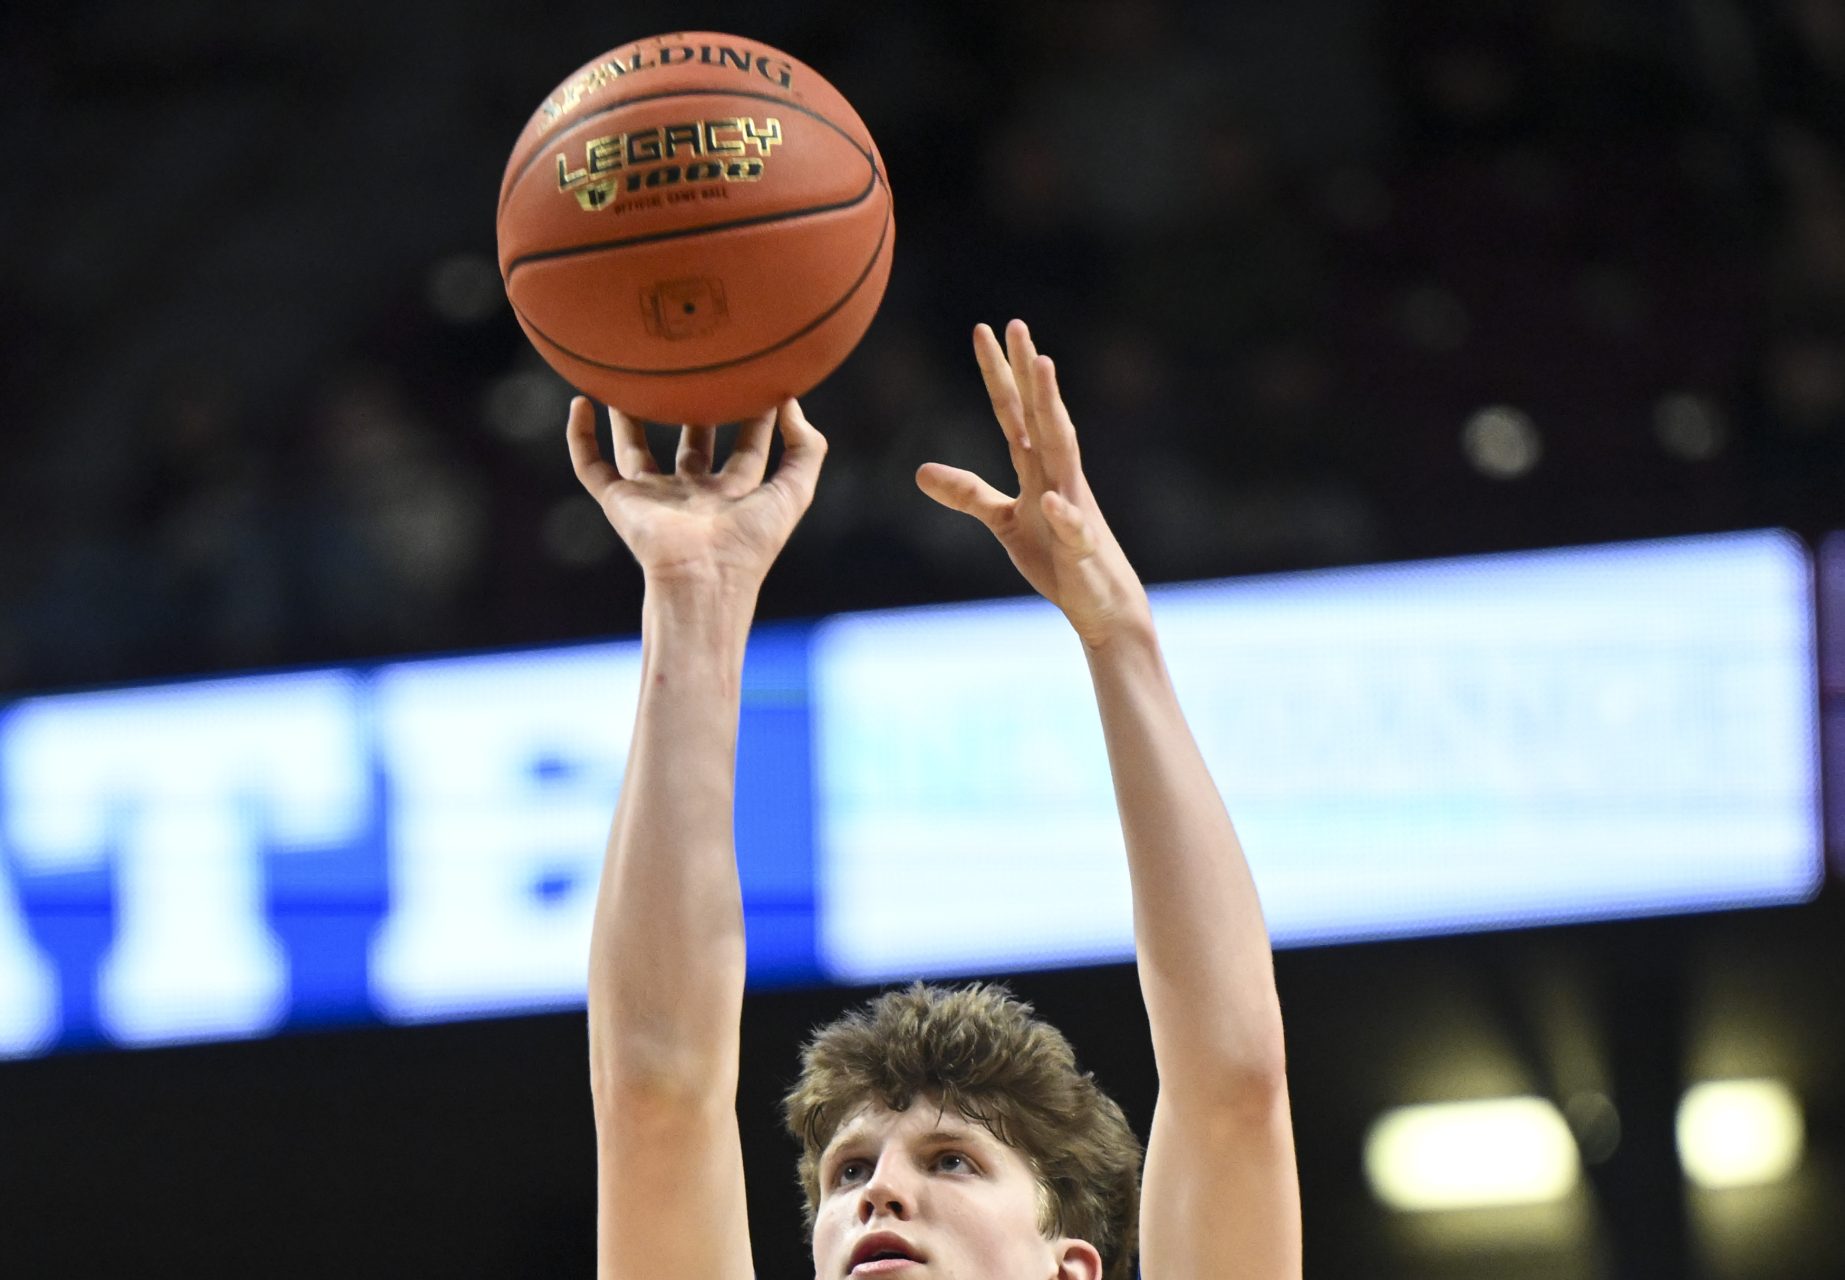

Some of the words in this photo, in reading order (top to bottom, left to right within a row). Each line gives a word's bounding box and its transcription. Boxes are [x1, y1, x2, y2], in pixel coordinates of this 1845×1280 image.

[556, 117, 783, 193] LEGACY
[625, 157, 765, 193] 1000
[0, 640, 645, 1058] TE
